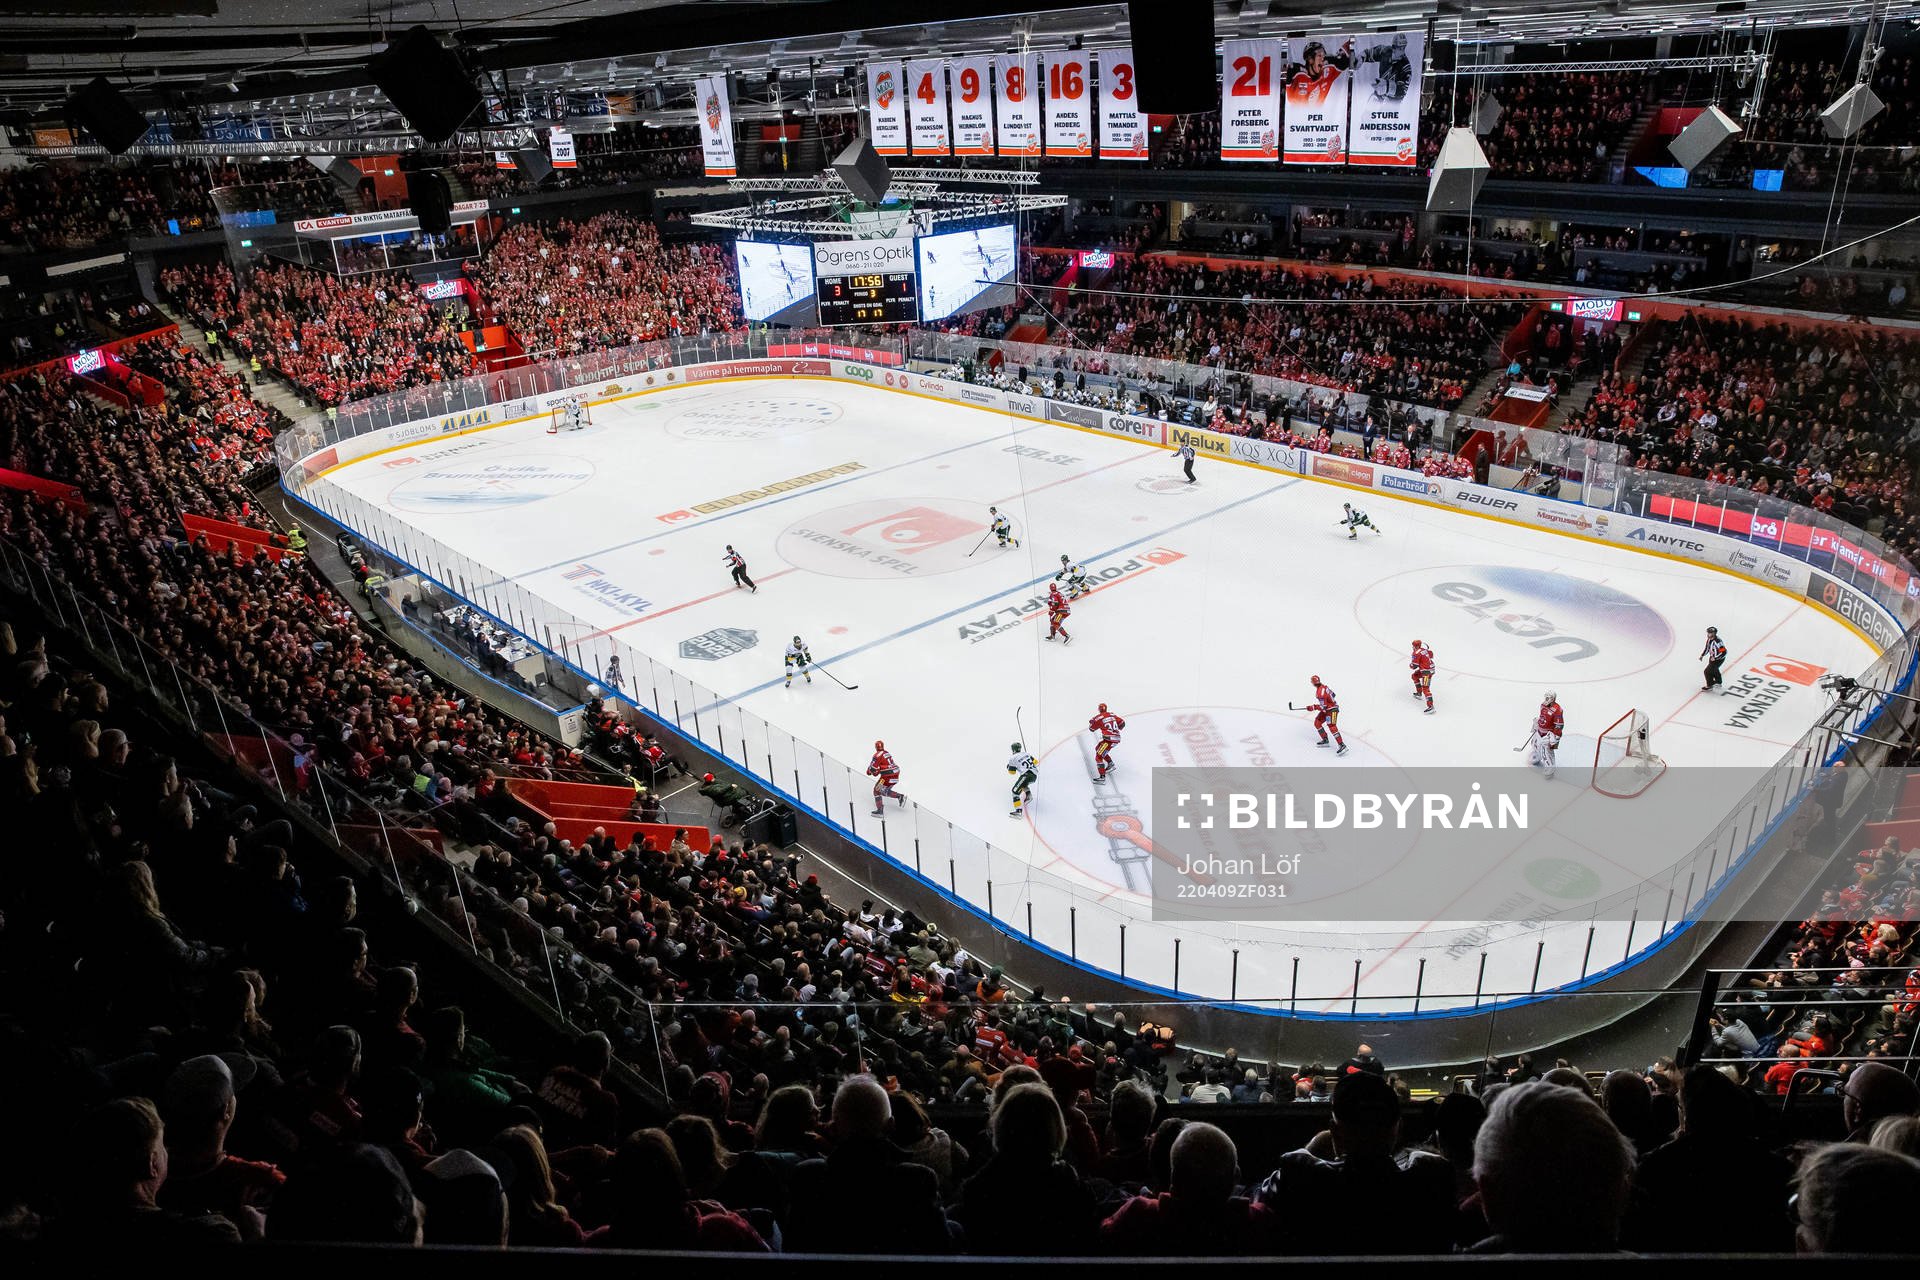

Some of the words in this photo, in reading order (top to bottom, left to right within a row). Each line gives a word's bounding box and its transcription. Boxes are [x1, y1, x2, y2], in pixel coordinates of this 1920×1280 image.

[1005, 66, 1027, 102] 8
[1050, 62, 1084, 100] 16
[1112, 63, 1133, 100] 3
[1232, 56, 1271, 96] 21
[917, 73, 936, 104] 4
[960, 68, 980, 103] 9
[1109, 112, 1136, 120] MATTIAS
[1231, 119, 1269, 127] FORSBERG
[1290, 125, 1339, 133] SVARTVADET
[1360, 123, 1410, 131] ANDERSSON
[556, 148, 570, 157] 2007
[298, 221, 313, 231] ICA
[318, 218, 350, 227] KVANTUM
[364, 213, 383, 222] RIKTIG
[454, 202, 473, 211] DAGAR
[816, 246, 870, 266] Ögrens
[873, 246, 913, 263] Optik
[1085, 253, 1109, 263] MODO
[854, 275, 881, 287] 17:56
[889, 274, 908, 282] GUEST
[427, 282, 455, 296] MODO
[835, 285, 841, 297] 3
[870, 289, 876, 298] 3
[1575, 299, 1613, 310] MODO
[74, 351, 97, 371] MODO
[692, 368, 719, 378] Värme
[722, 366, 732, 377] på
[734, 363, 782, 375] hemmaplan
[845, 364, 873, 381] coop
[919, 379, 944, 392] Cylinda
[1008, 400, 1032, 413] miva
[1172, 428, 1225, 452] Malux
[1233, 440, 1260, 460] XQS
[1267, 446, 1295, 468] XQS
[1384, 476, 1425, 493] Polarbröd
[1456, 491, 1518, 512] BAUER
[1536, 511, 1593, 529] Magnussons
[1648, 533, 1704, 552] ANYTEC
[792, 528, 871, 559] SVENSKA
[869, 554, 919, 575] SPEL
[1738, 552, 1758, 564] Svensk
[1739, 560, 1756, 569] Cater
[1772, 563, 1792, 576] Svensk
[1773, 570, 1790, 581] Cater
[688, 635, 734, 658] 2022
[1720, 674, 1764, 698] SPEL
[1724, 681, 1790, 729] SVENSKA
